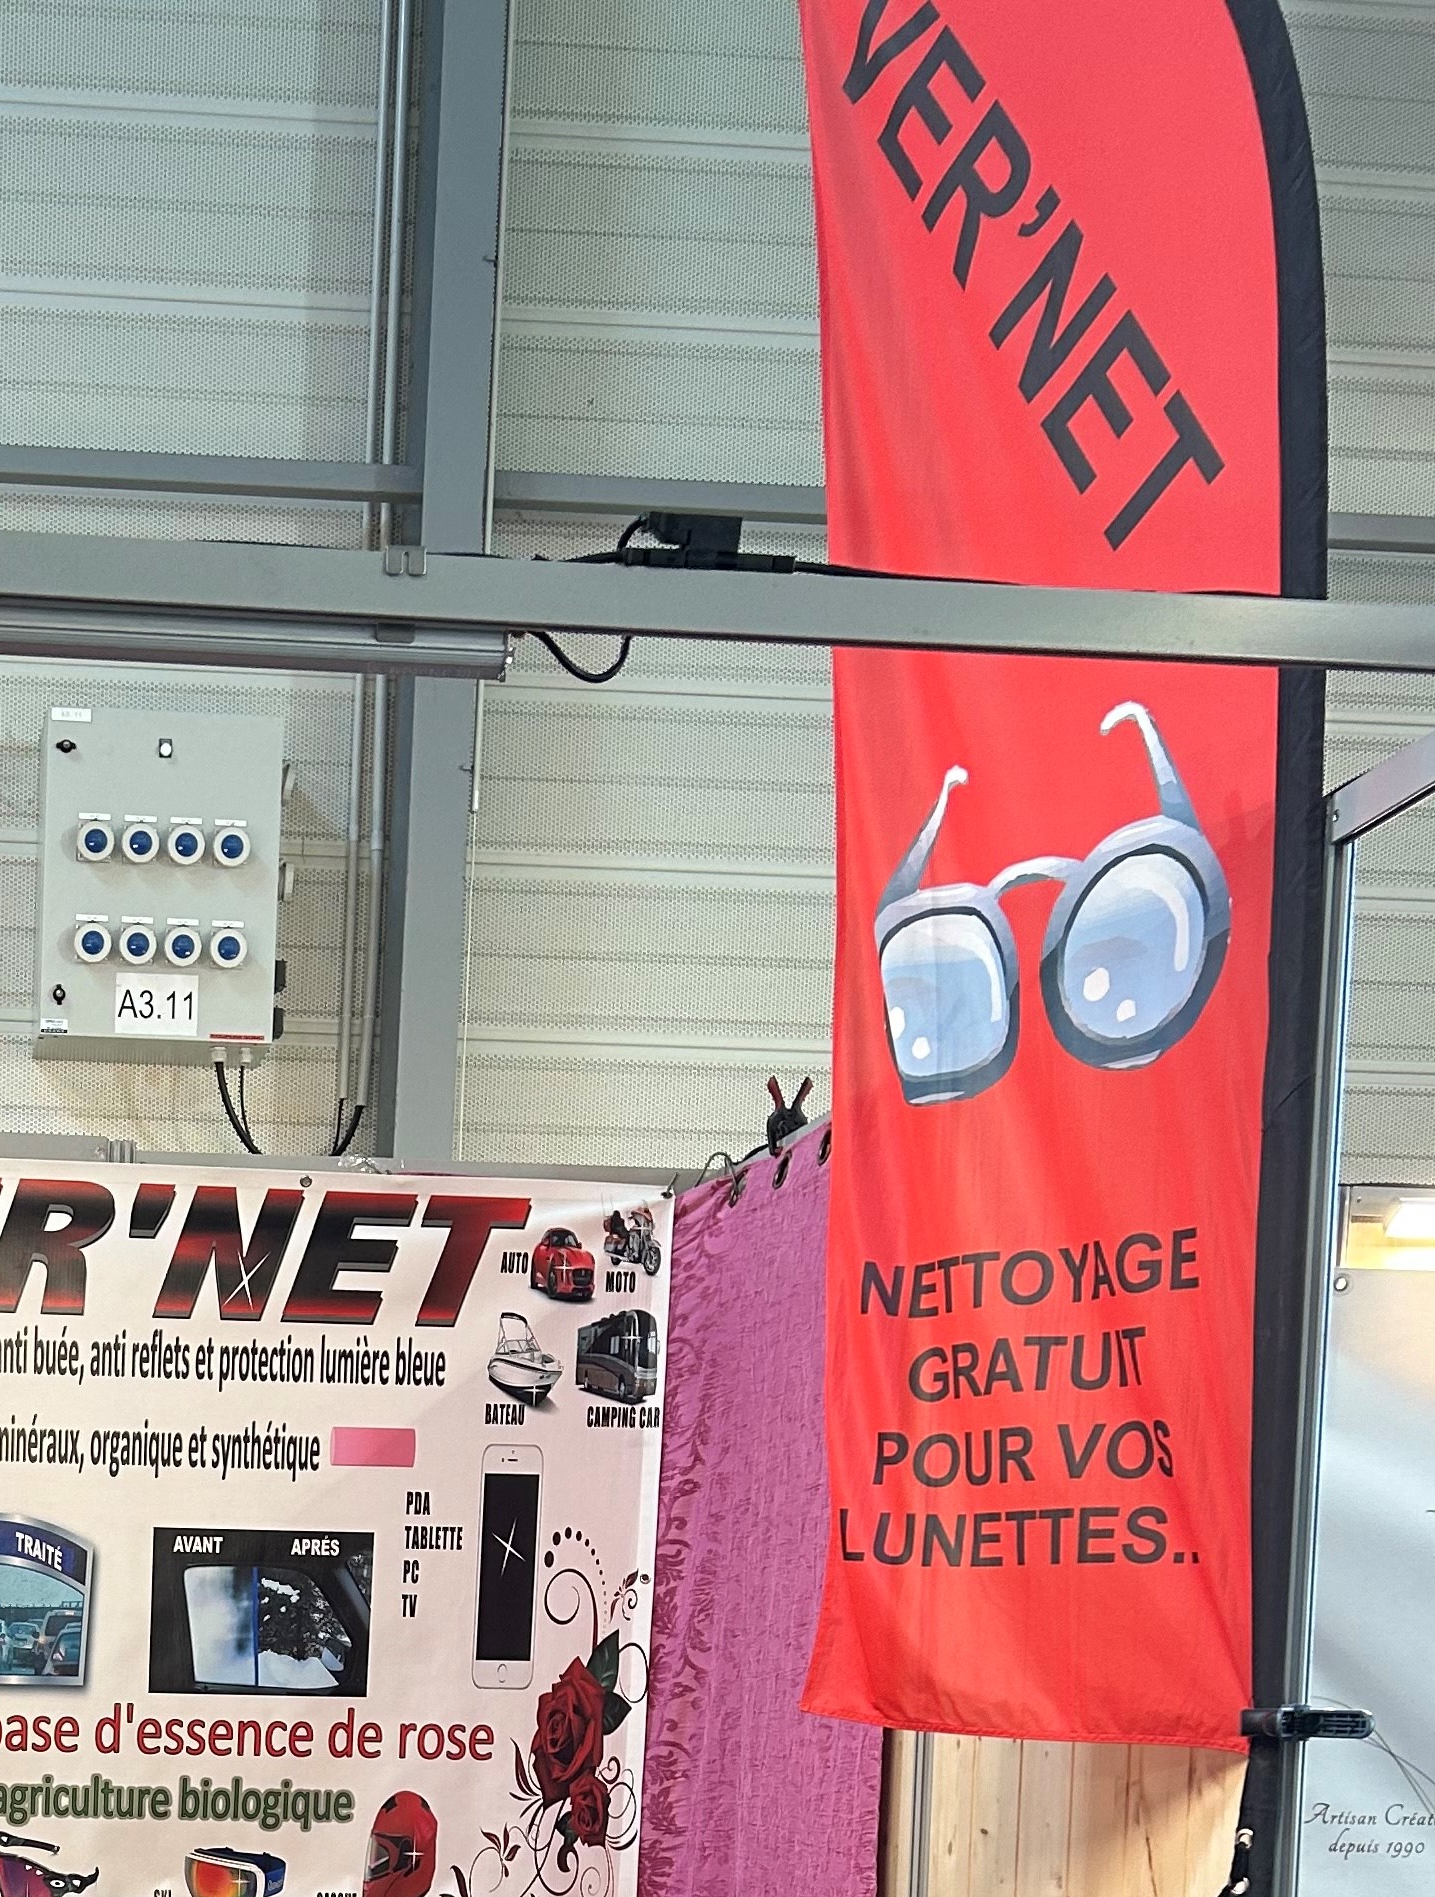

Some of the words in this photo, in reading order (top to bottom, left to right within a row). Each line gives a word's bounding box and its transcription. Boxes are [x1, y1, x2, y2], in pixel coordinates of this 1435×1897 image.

[843, 0, 1225, 552] VER'NET
[117, 989, 194, 1020] A3.11
[501, 1252, 529, 1274] AUTO
[860, 1227, 1201, 1319] NETTOYAGE
[606, 1271, 636, 1293] MOTO
[34, 1326, 85, 1385] buée,
[90, 1330, 126, 1378] anti
[132, 1333, 190, 1381] reflets
[195, 1341, 214, 1380] et
[219, 1336, 314, 1392] protection
[320, 1335, 390, 1387] lumière
[395, 1337, 446, 1387] bleue
[908, 1327, 1146, 1403] GRATUIT
[485, 1403, 525, 1426] BATEAU
[587, 1406, 636, 1429] CAMPING
[639, 1407, 660, 1428] CAR
[90, 1420, 181, 1479] organique
[188, 1426, 206, 1468] et
[211, 1419, 320, 1483] synthétique
[873, 1425, 1036, 1487] POUR
[1057, 1418, 1174, 1479] VOS
[405, 1491, 431, 1516] PDA
[15, 1531, 63, 1571] TRAITÉ
[173, 1535, 224, 1554] AVANT
[404, 1525, 463, 1551] TABLETTE
[402, 1559, 419, 1584] PC
[401, 1594, 417, 1618] TV
[95, 1702, 313, 1758] d'essence
[328, 1707, 383, 1760] de
[398, 1720, 495, 1761] rose
[177, 1775, 356, 1833] biologique
[1304, 1802, 1377, 1825] Artisan
[1328, 1828, 1380, 1860] depuis
[1386, 1842, 1425, 1858] 1990
